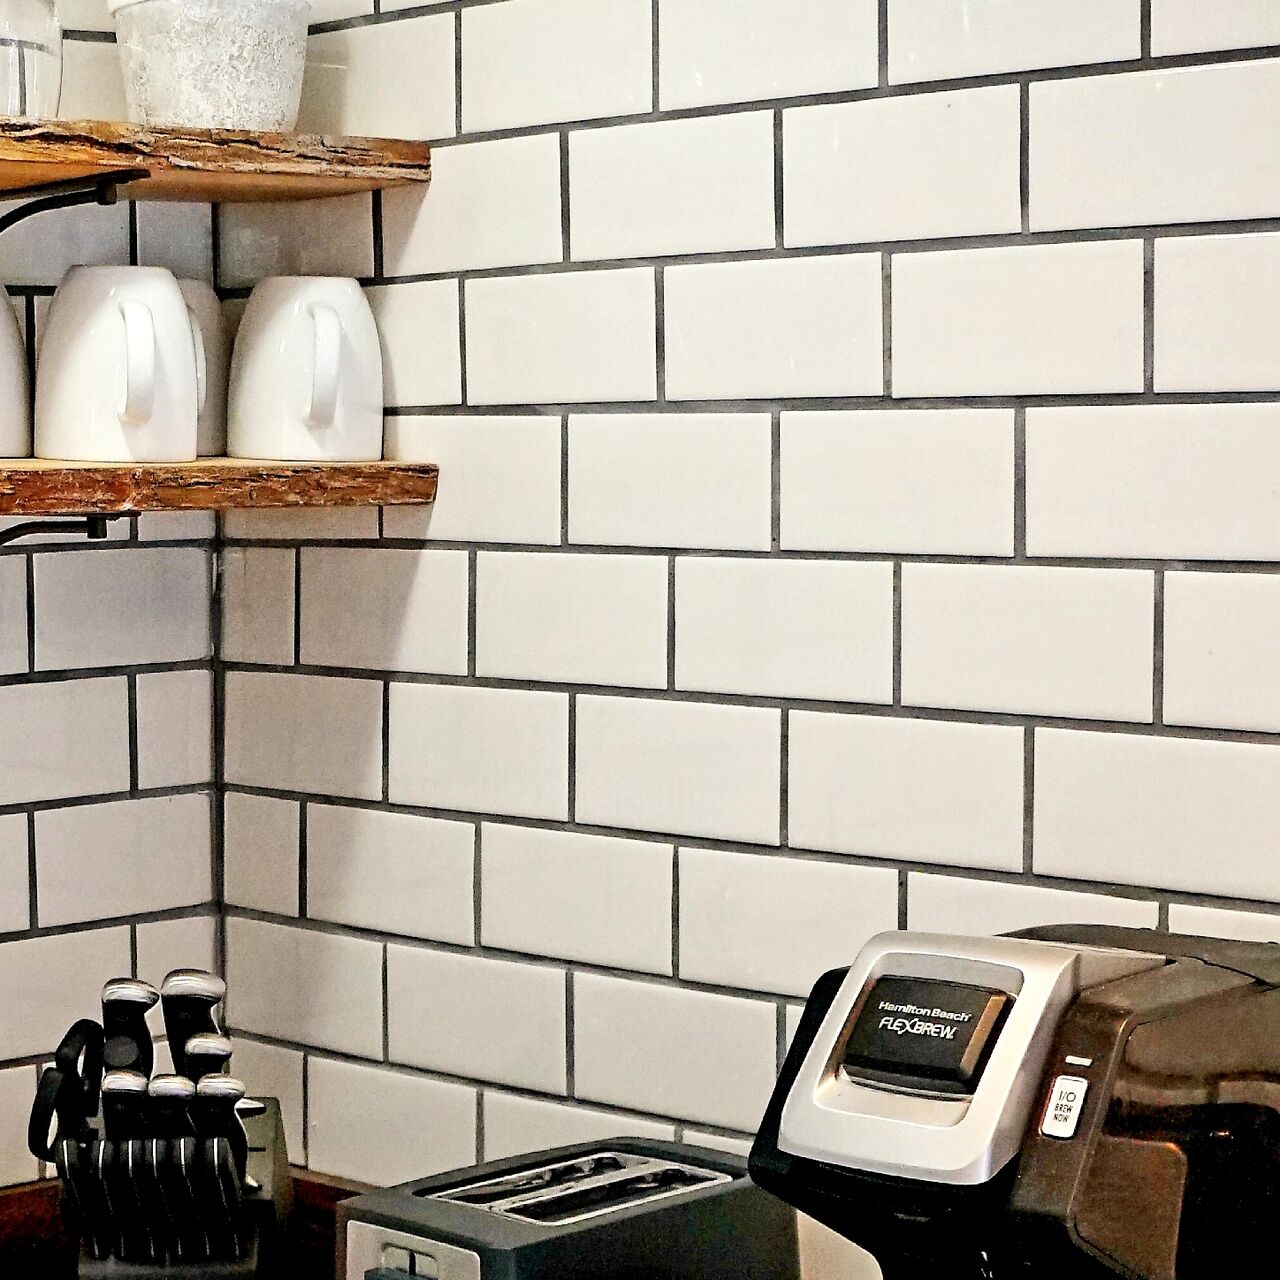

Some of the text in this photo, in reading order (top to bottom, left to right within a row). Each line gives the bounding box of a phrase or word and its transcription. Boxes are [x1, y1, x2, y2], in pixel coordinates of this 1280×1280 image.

[878, 1000, 971, 1022] Hamilton Beach
[1055, 1103, 1073, 1113] BREW
[1053, 1114, 1069, 1122] NOW
